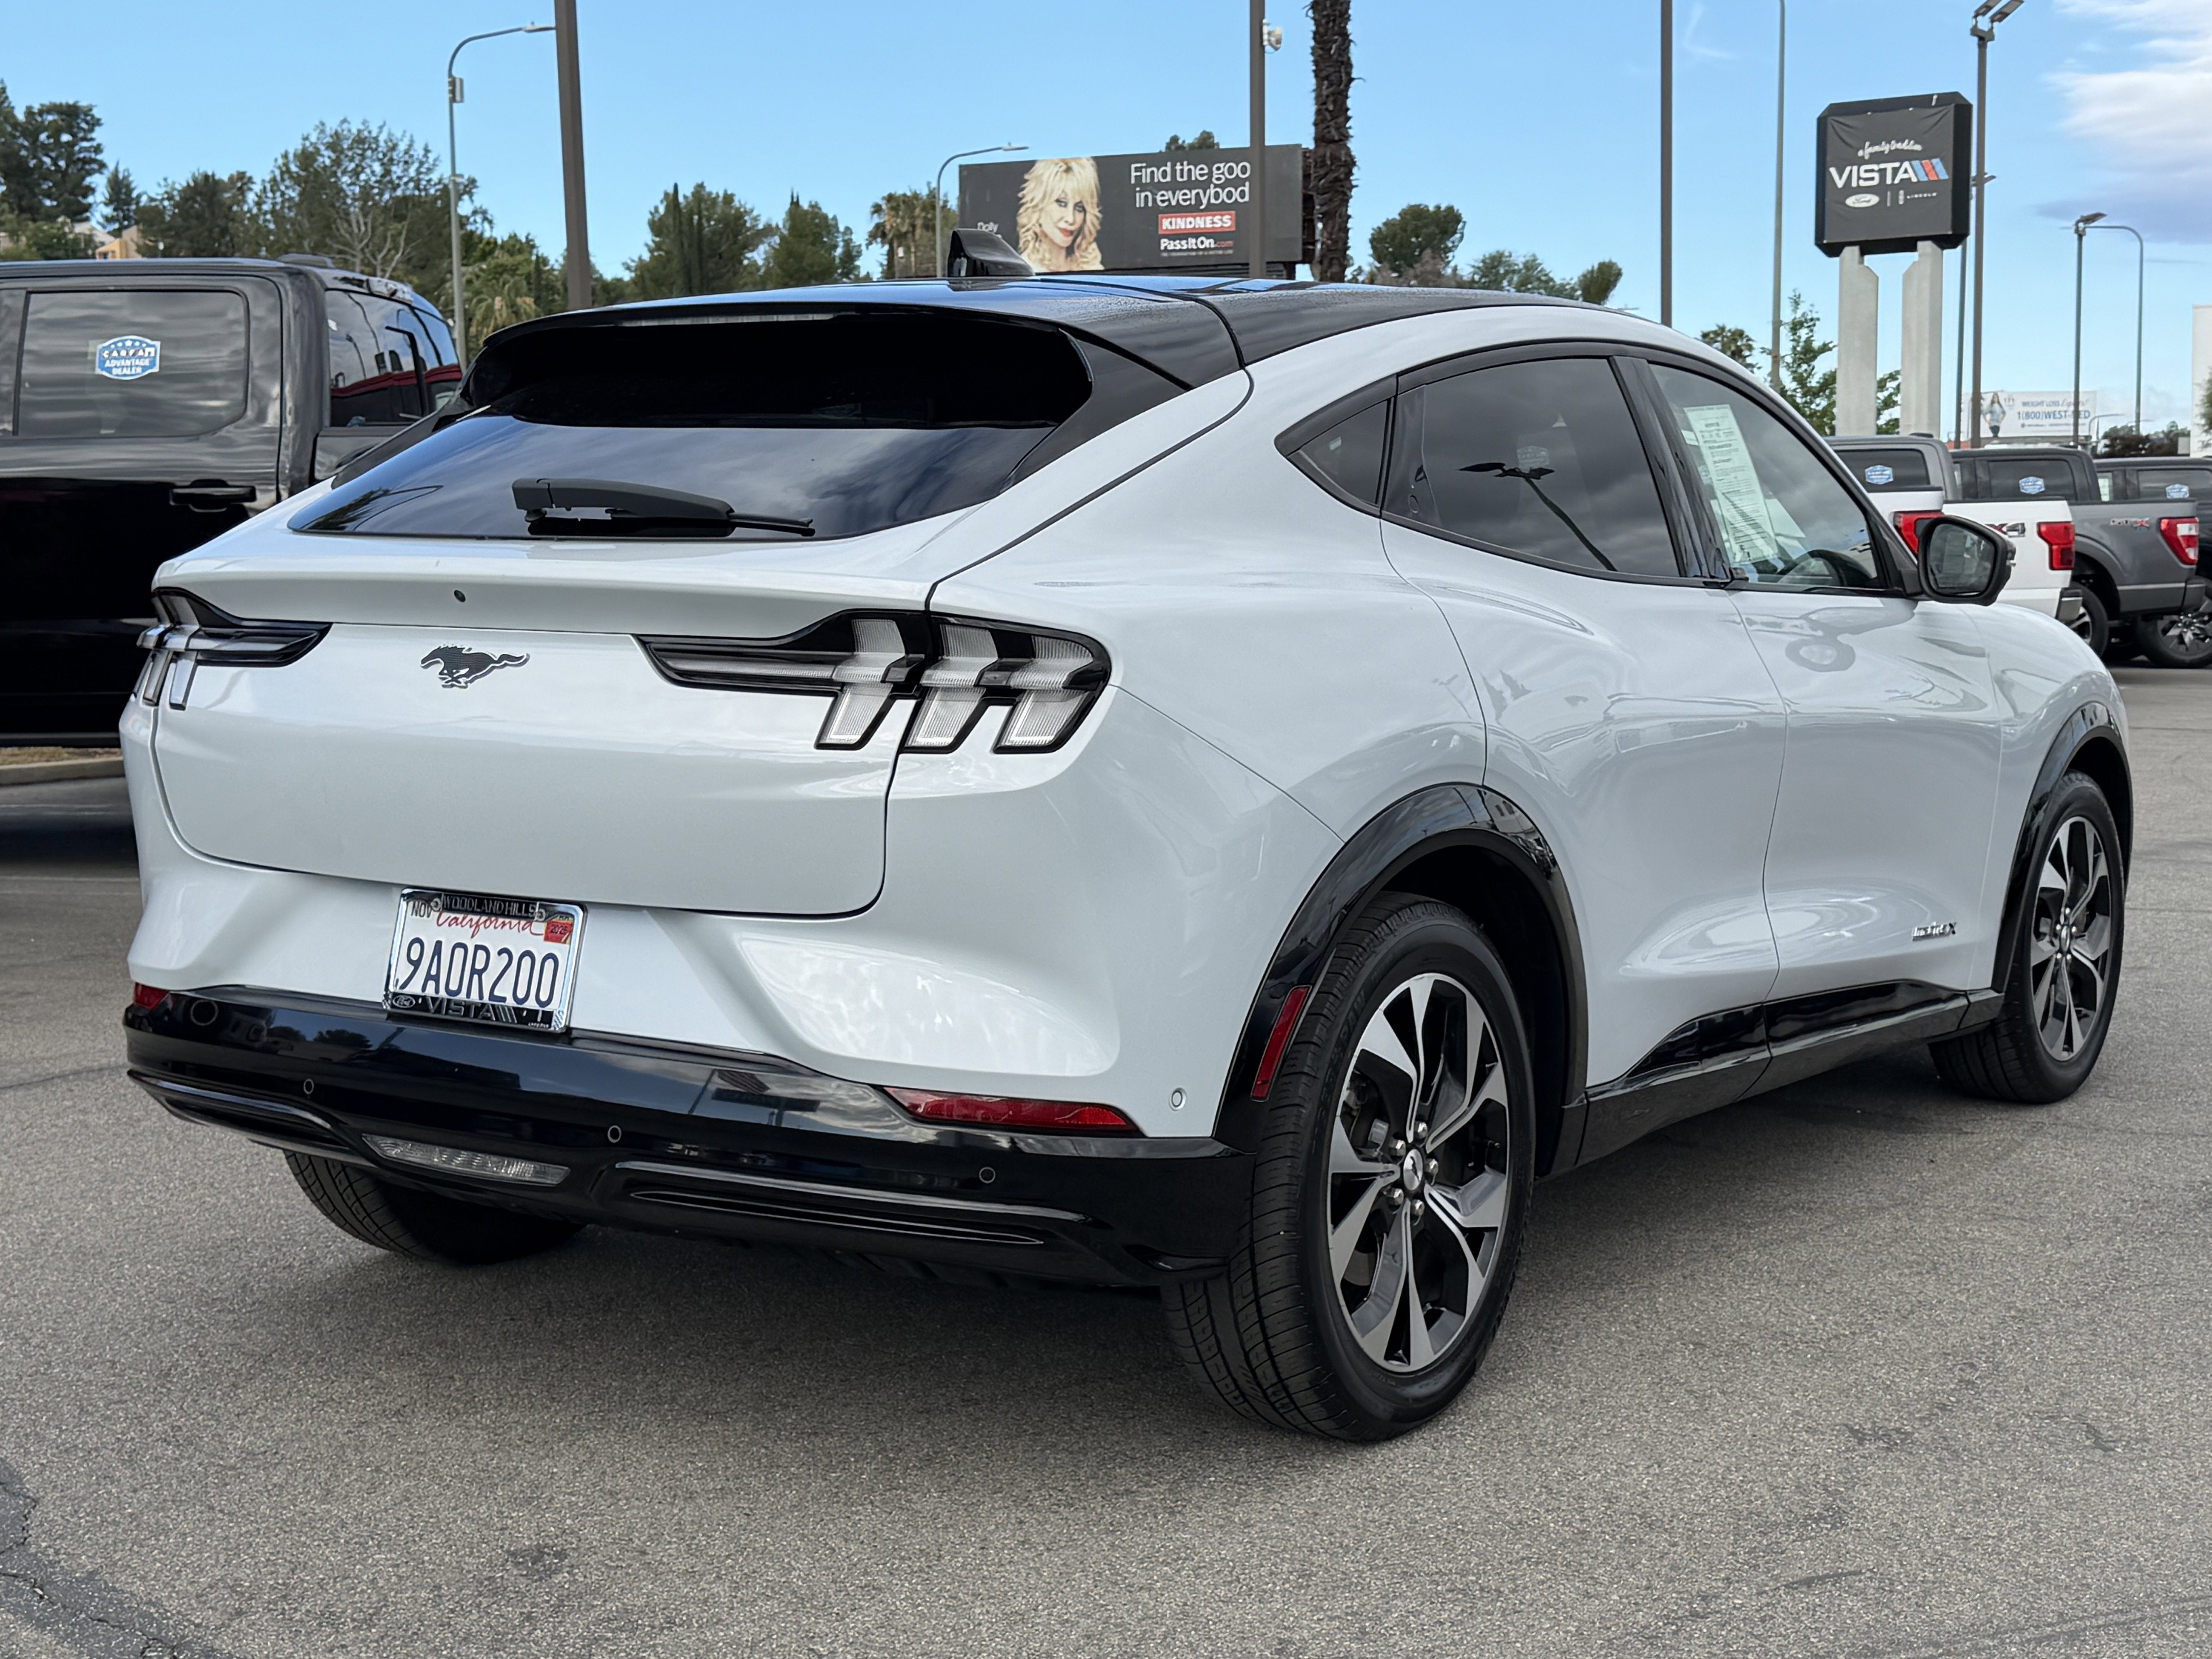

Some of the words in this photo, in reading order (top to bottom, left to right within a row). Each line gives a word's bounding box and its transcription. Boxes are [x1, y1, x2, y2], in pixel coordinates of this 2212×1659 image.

[1130, 161, 1171, 184] Find
[1175, 161, 1209, 181] the
[1212, 161, 1251, 184] goo
[1829, 161, 1918, 188] VISTA
[1135, 187, 1152, 208] in
[1156, 181, 1250, 209] everybod
[1162, 215, 1231, 230] KINDNESS
[2017, 410, 2090, 420] 1(800)WEST-ED
[411, 900, 432, 918] NOV
[442, 895, 503, 914] WOODLAND
[505, 902, 536, 917] HILLS
[436, 911, 544, 939] California
[399, 937, 559, 1008] 9AOR200
[426, 996, 496, 1021] VISTA
